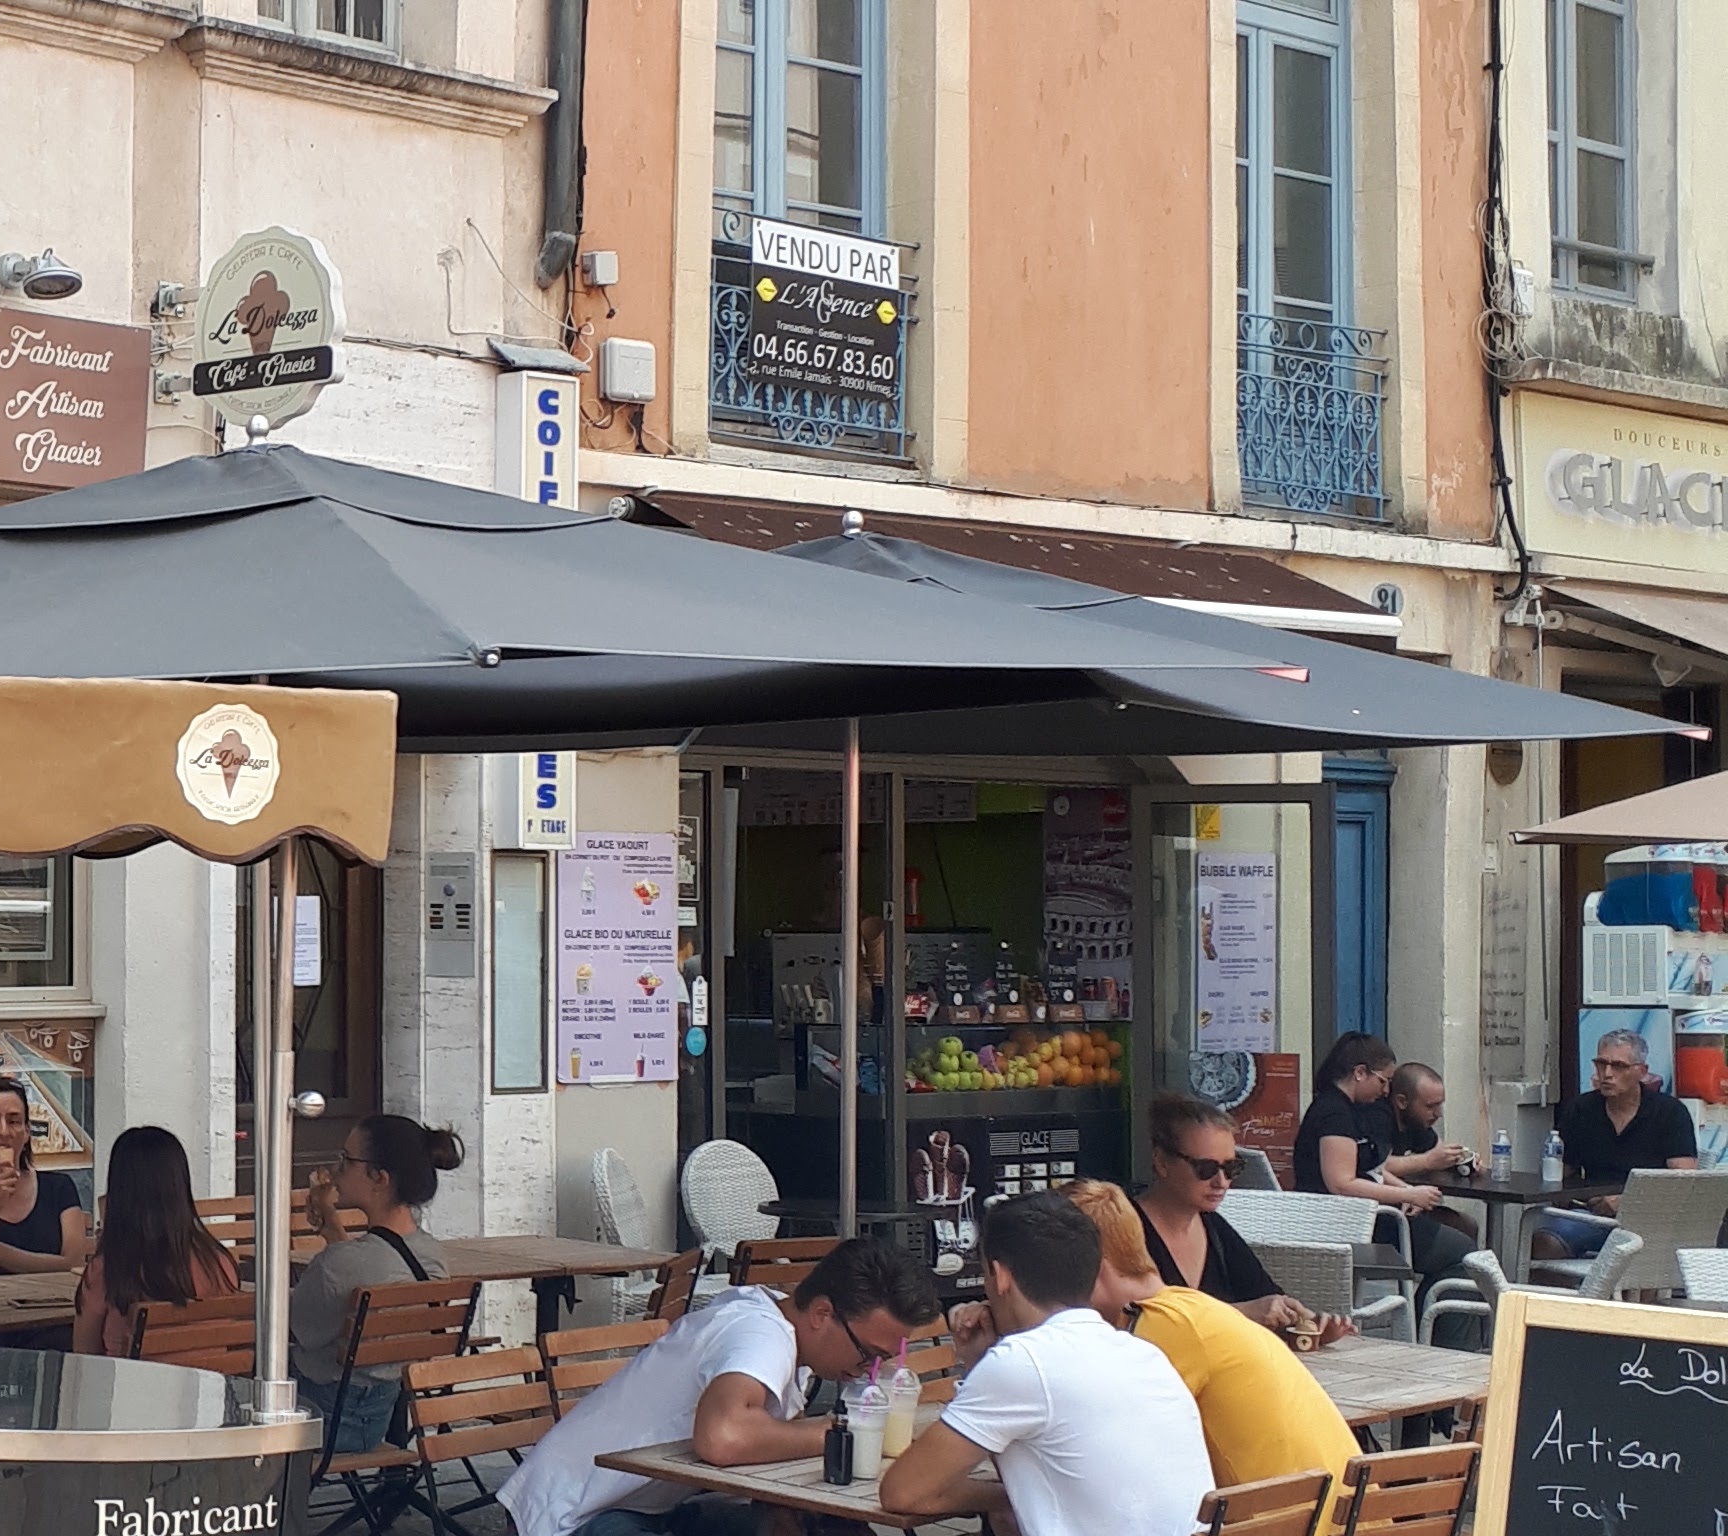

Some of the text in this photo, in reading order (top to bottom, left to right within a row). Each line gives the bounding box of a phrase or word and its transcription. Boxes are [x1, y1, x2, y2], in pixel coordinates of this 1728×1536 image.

[758, 229, 892, 285] VENDU PAR
[208, 303, 319, 345] La Dolcezza
[776, 320, 875, 346] Transaction Gestion Location
[753, 333, 894, 380] 04.66.67.83.60
[208, 353, 316, 391] Café Glacier
[762, 364, 777, 375] rue
[779, 365, 803, 379] Emile
[804, 370, 832, 385] Jamais
[839, 375, 865, 390] 30900
[4, 380, 105, 421] Artisan
[15, 428, 103, 473] Glacier
[536, 388, 562, 505] COIF
[1613, 427, 1722, 457] DOUCEURS
[1377, 588, 1397, 614] 21
[189, 747, 213, 769] La
[541, 819, 566, 833] ETAGE
[586, 839, 648, 850] GLACE YAOURT
[1200, 865, 1273, 877] BUBBLE WAFFLE
[564, 929, 671, 939] GLACE BIO OU NATURELLE
[1020, 1130, 1050, 1145] GLACE
[1619, 1343, 1727, 1385] La Dol
[1532, 1409, 1681, 1473] Artisan
